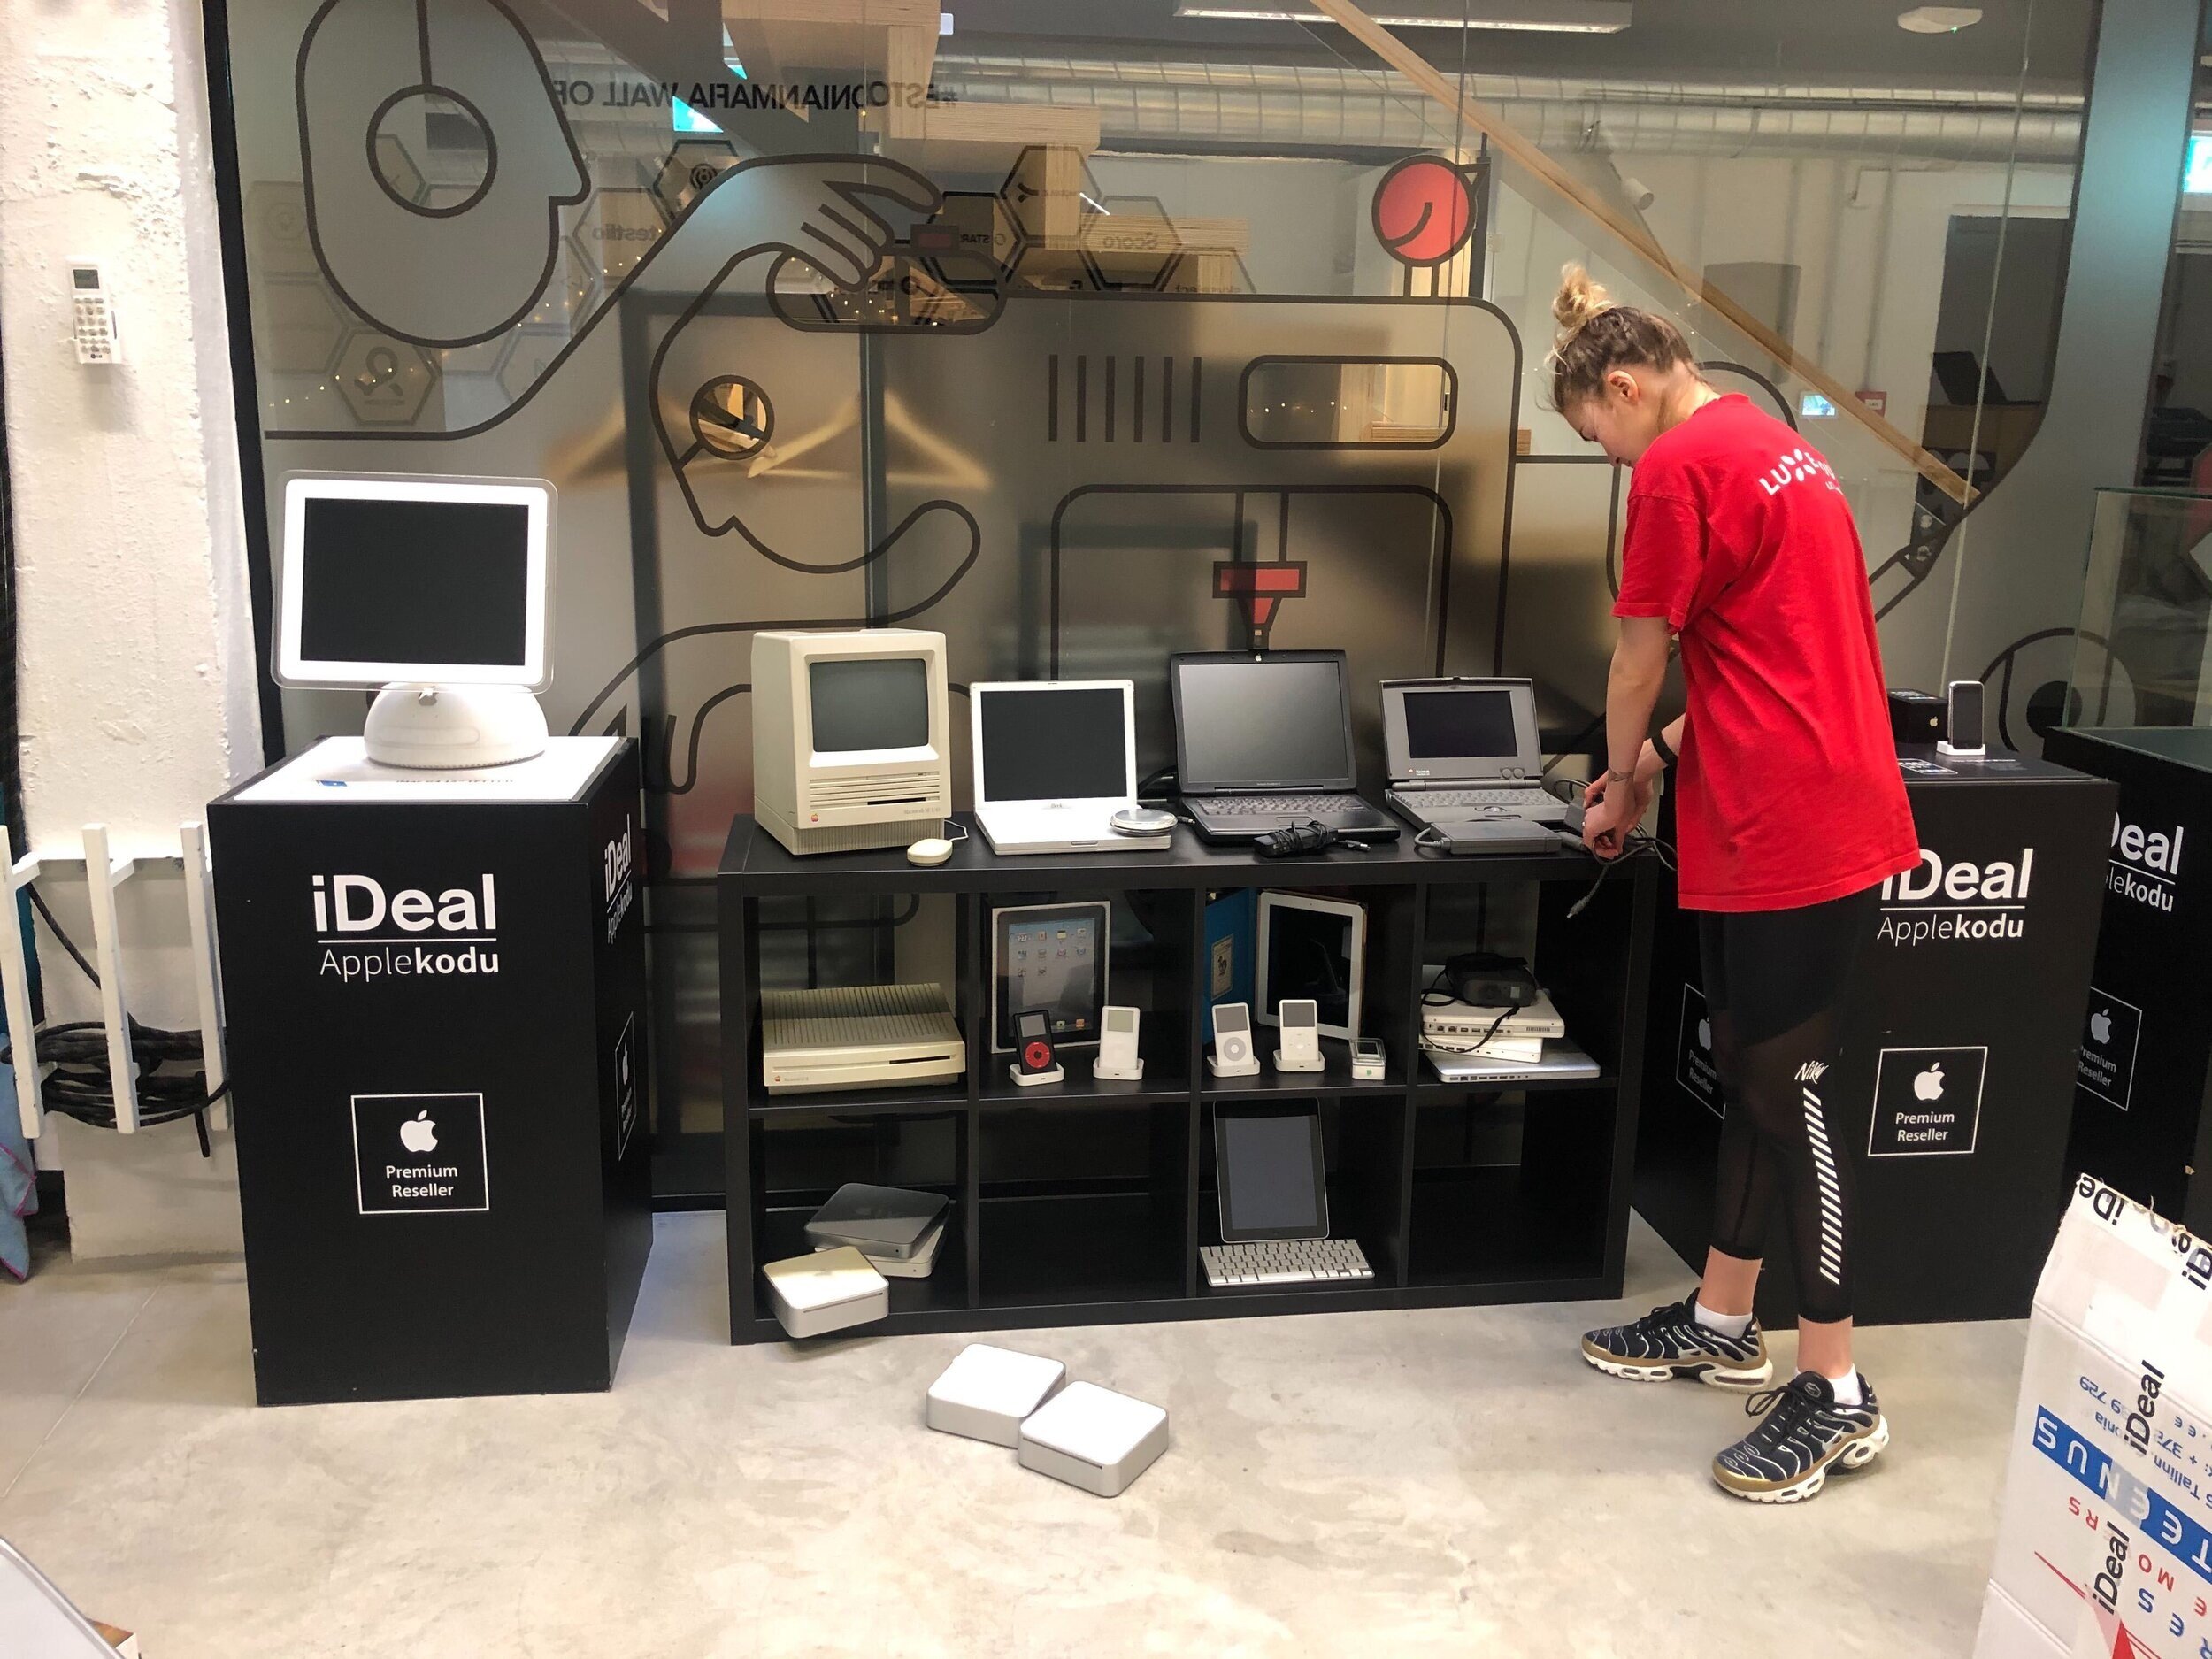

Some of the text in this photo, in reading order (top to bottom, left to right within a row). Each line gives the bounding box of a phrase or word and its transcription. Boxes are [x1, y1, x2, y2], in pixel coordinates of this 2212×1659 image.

[604, 813, 632, 902] iDeal
[312, 873, 496, 932] iDeal
[1877, 912, 2024, 947] Applekodu
[319, 946, 499, 983] Applekodu
[2078, 1060, 2113, 1087] Reseller
[1894, 1111, 1955, 1125] Premium
[1897, 1129, 1949, 1142] Reseller
[385, 1164, 458, 1179] Premium
[391, 1183, 455, 1198] Reseller
[2079, 1376, 2107, 1404] 729
[2124, 1359, 2165, 1455] iDeal
[2092, 1520, 2130, 1616] iDeal
